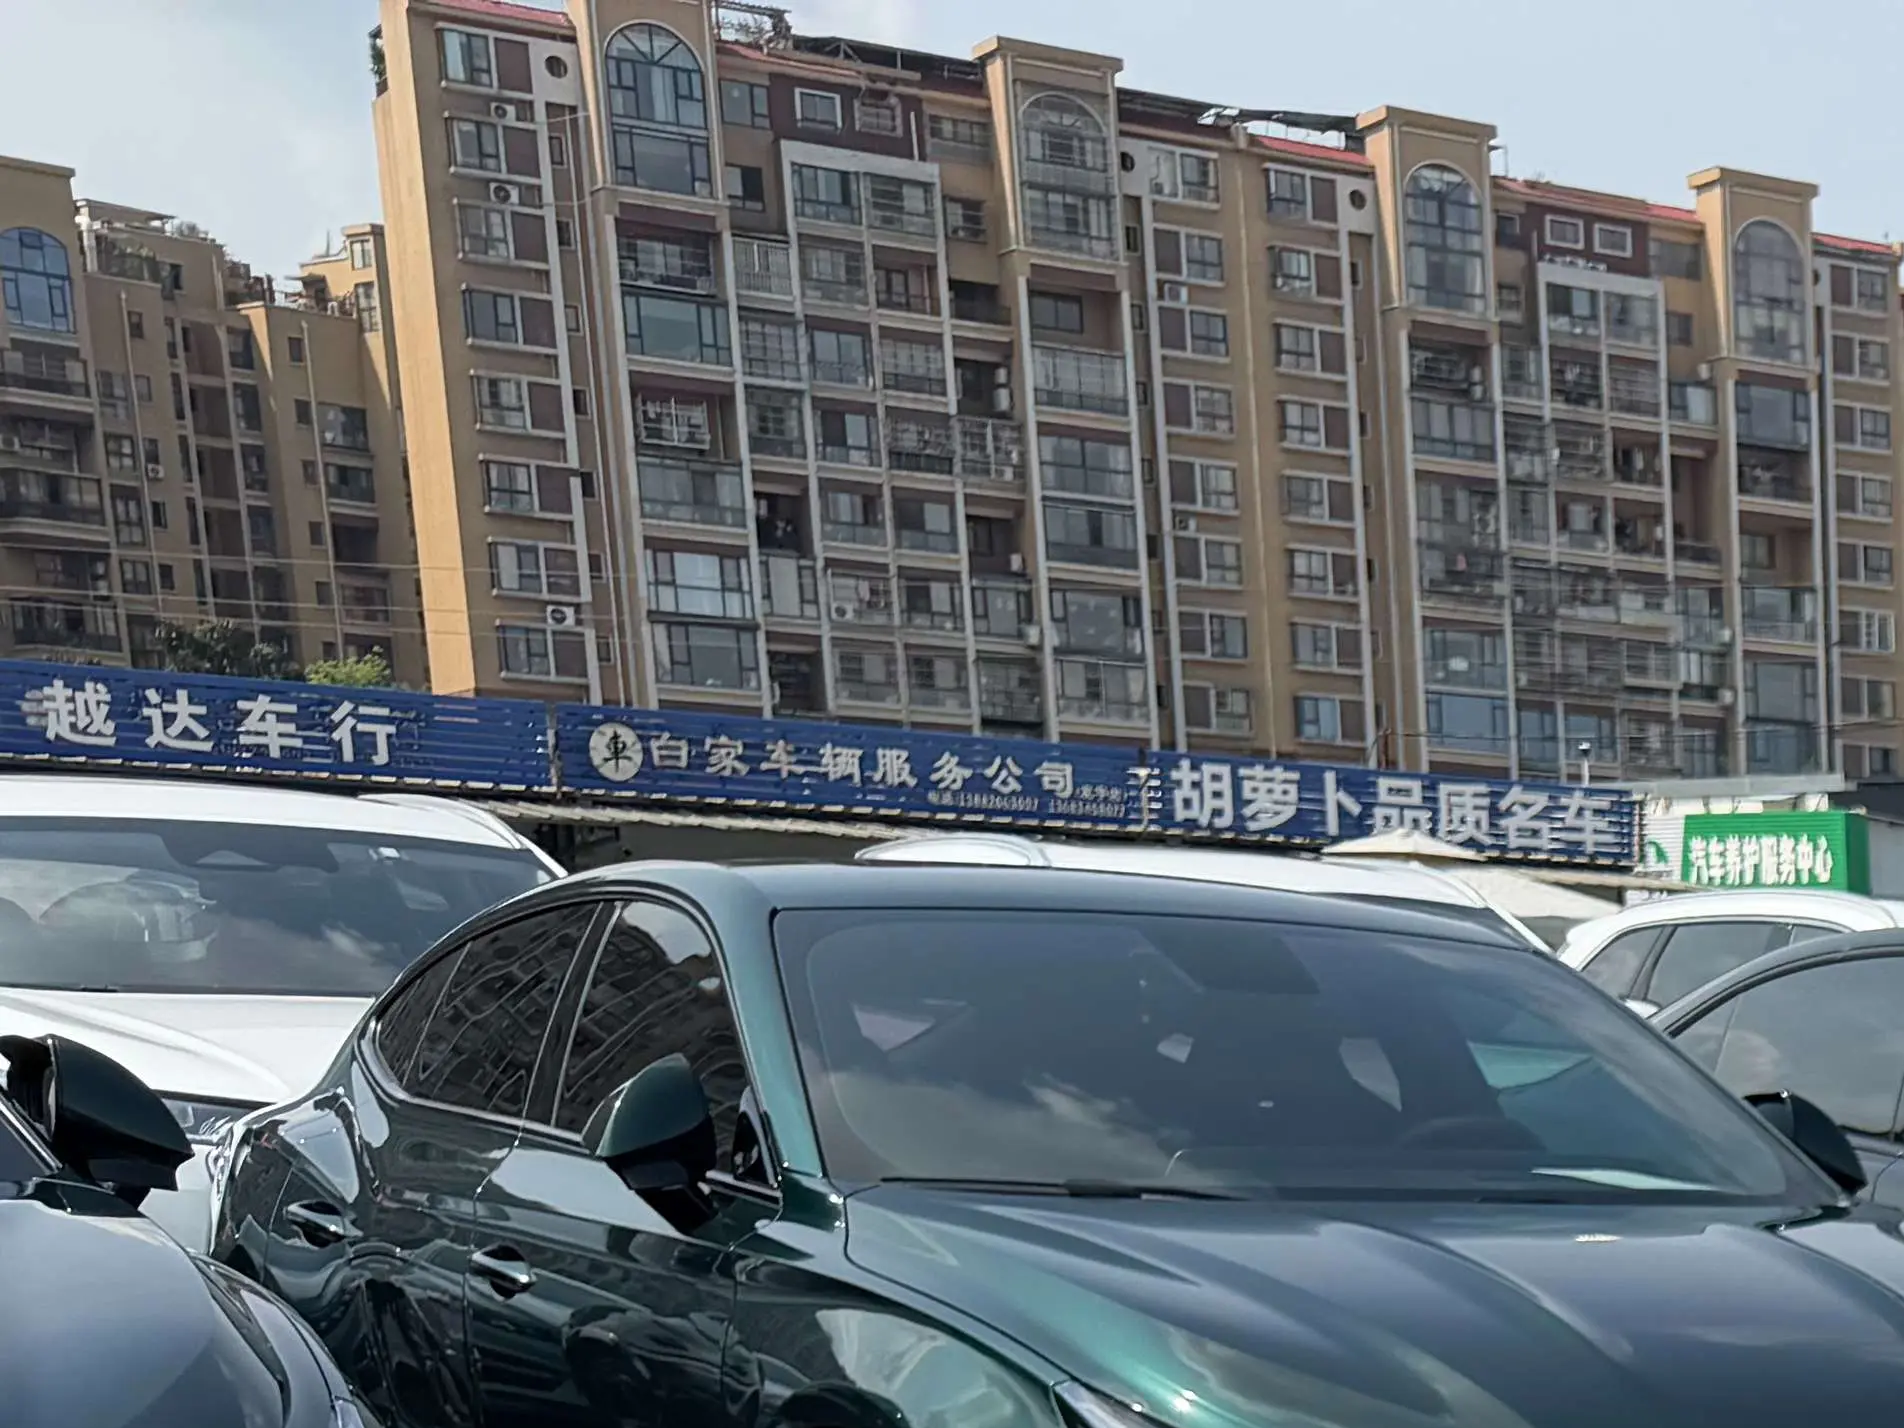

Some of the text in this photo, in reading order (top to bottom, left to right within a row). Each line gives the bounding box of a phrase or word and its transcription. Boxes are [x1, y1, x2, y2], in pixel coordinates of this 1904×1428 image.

[44, 680, 397, 766] 越达车行
[650, 731, 1074, 799] 白家车辆服务公司
[1170, 758, 1618, 853] 胡萝卜品质名车
[1688, 833, 1833, 885] 汽车养护服务中心
